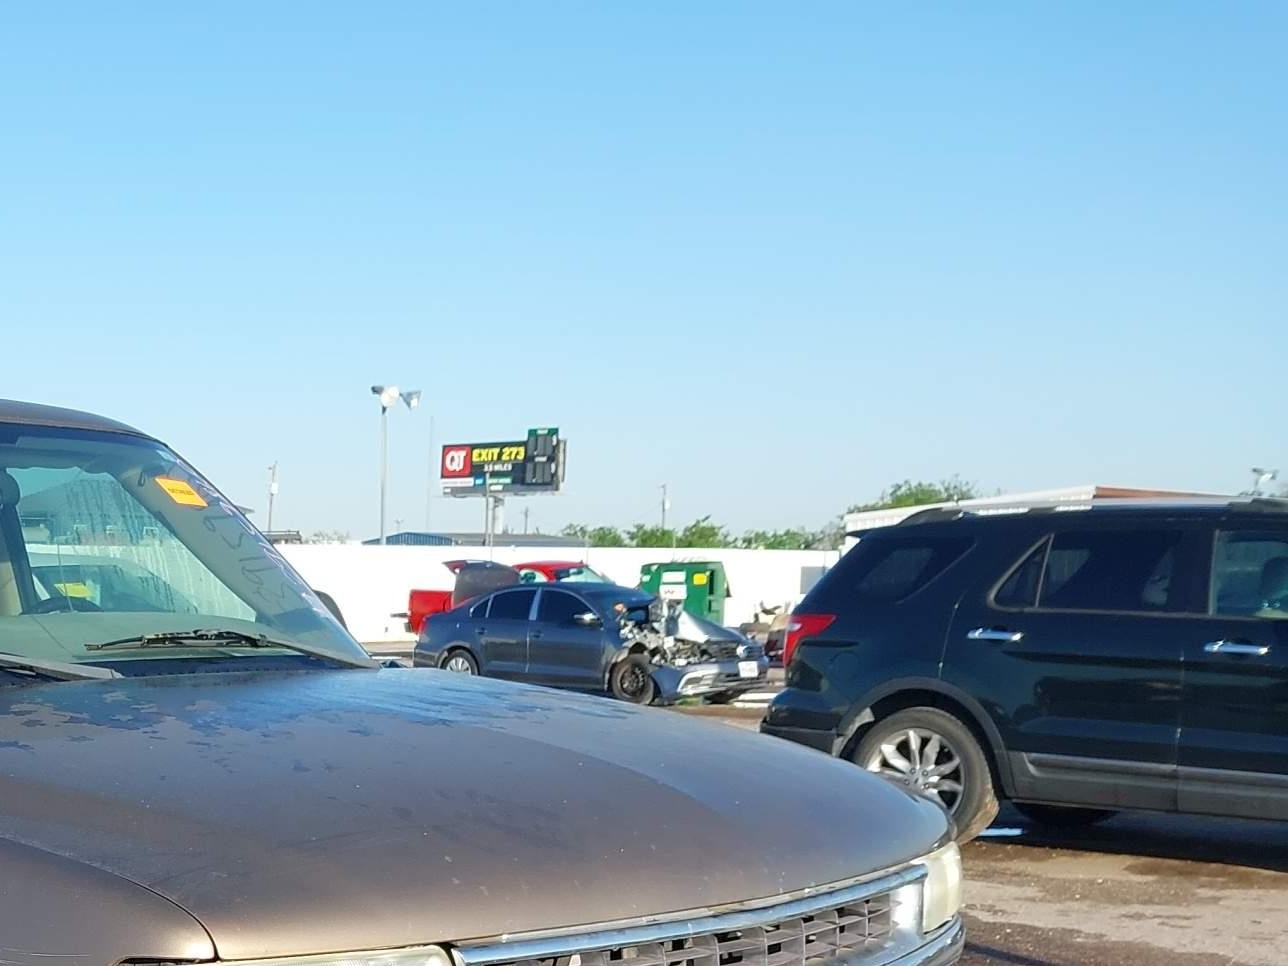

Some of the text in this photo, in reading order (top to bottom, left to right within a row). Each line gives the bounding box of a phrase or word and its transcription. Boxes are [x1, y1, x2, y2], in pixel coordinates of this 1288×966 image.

[445, 450, 467, 472] QT
[472, 446, 525, 463] EXIT 273
